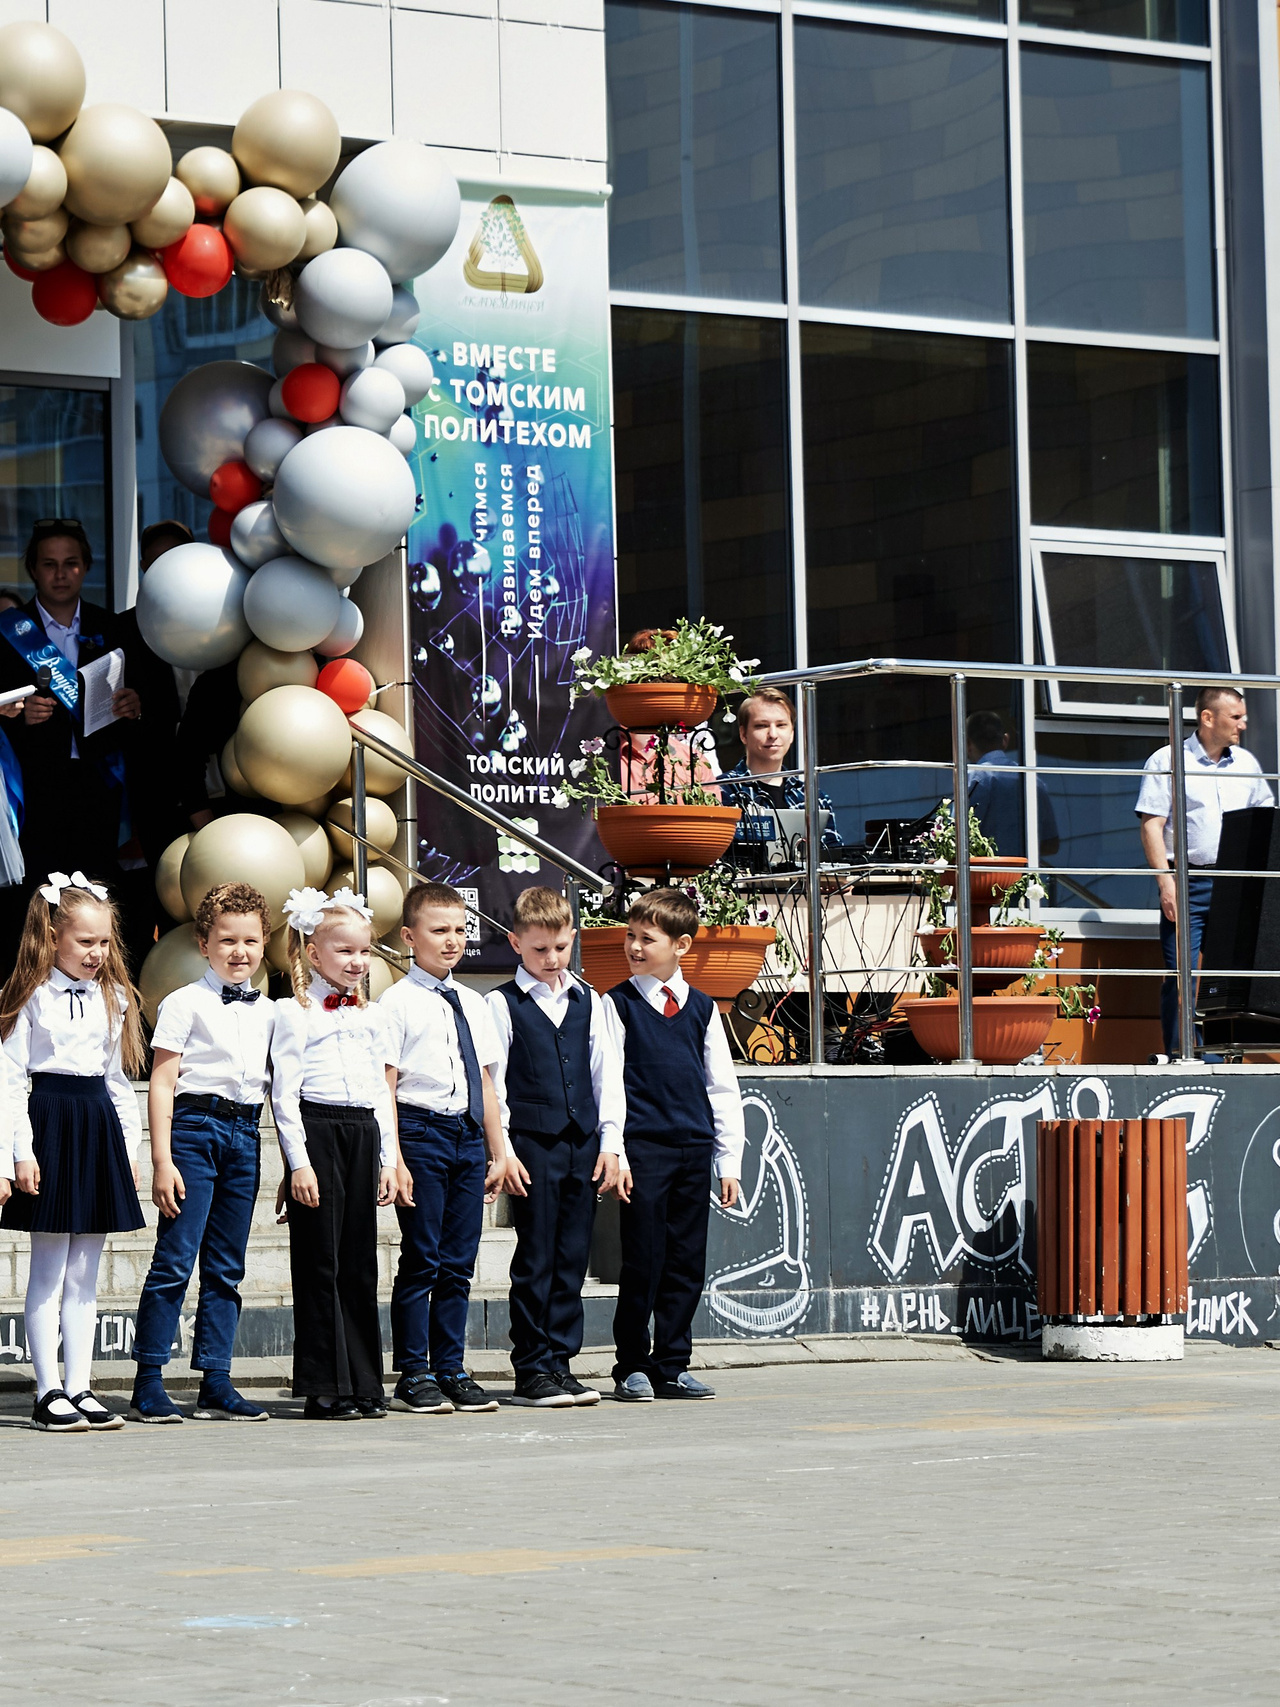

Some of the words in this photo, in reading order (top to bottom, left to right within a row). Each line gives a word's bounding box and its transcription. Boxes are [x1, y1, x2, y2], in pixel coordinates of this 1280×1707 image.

[452, 341, 557, 373] ВМЕСТЕ
[449, 379, 586, 412] ТОМСКИМ
[424, 414, 592, 449] ПОЛИТЕХОМ
[526, 464, 544, 560] вперед
[500, 464, 517, 635] Развиваемся
[526, 568, 544, 640] Идем
[466, 752, 565, 776] ТОМСКИЙ
